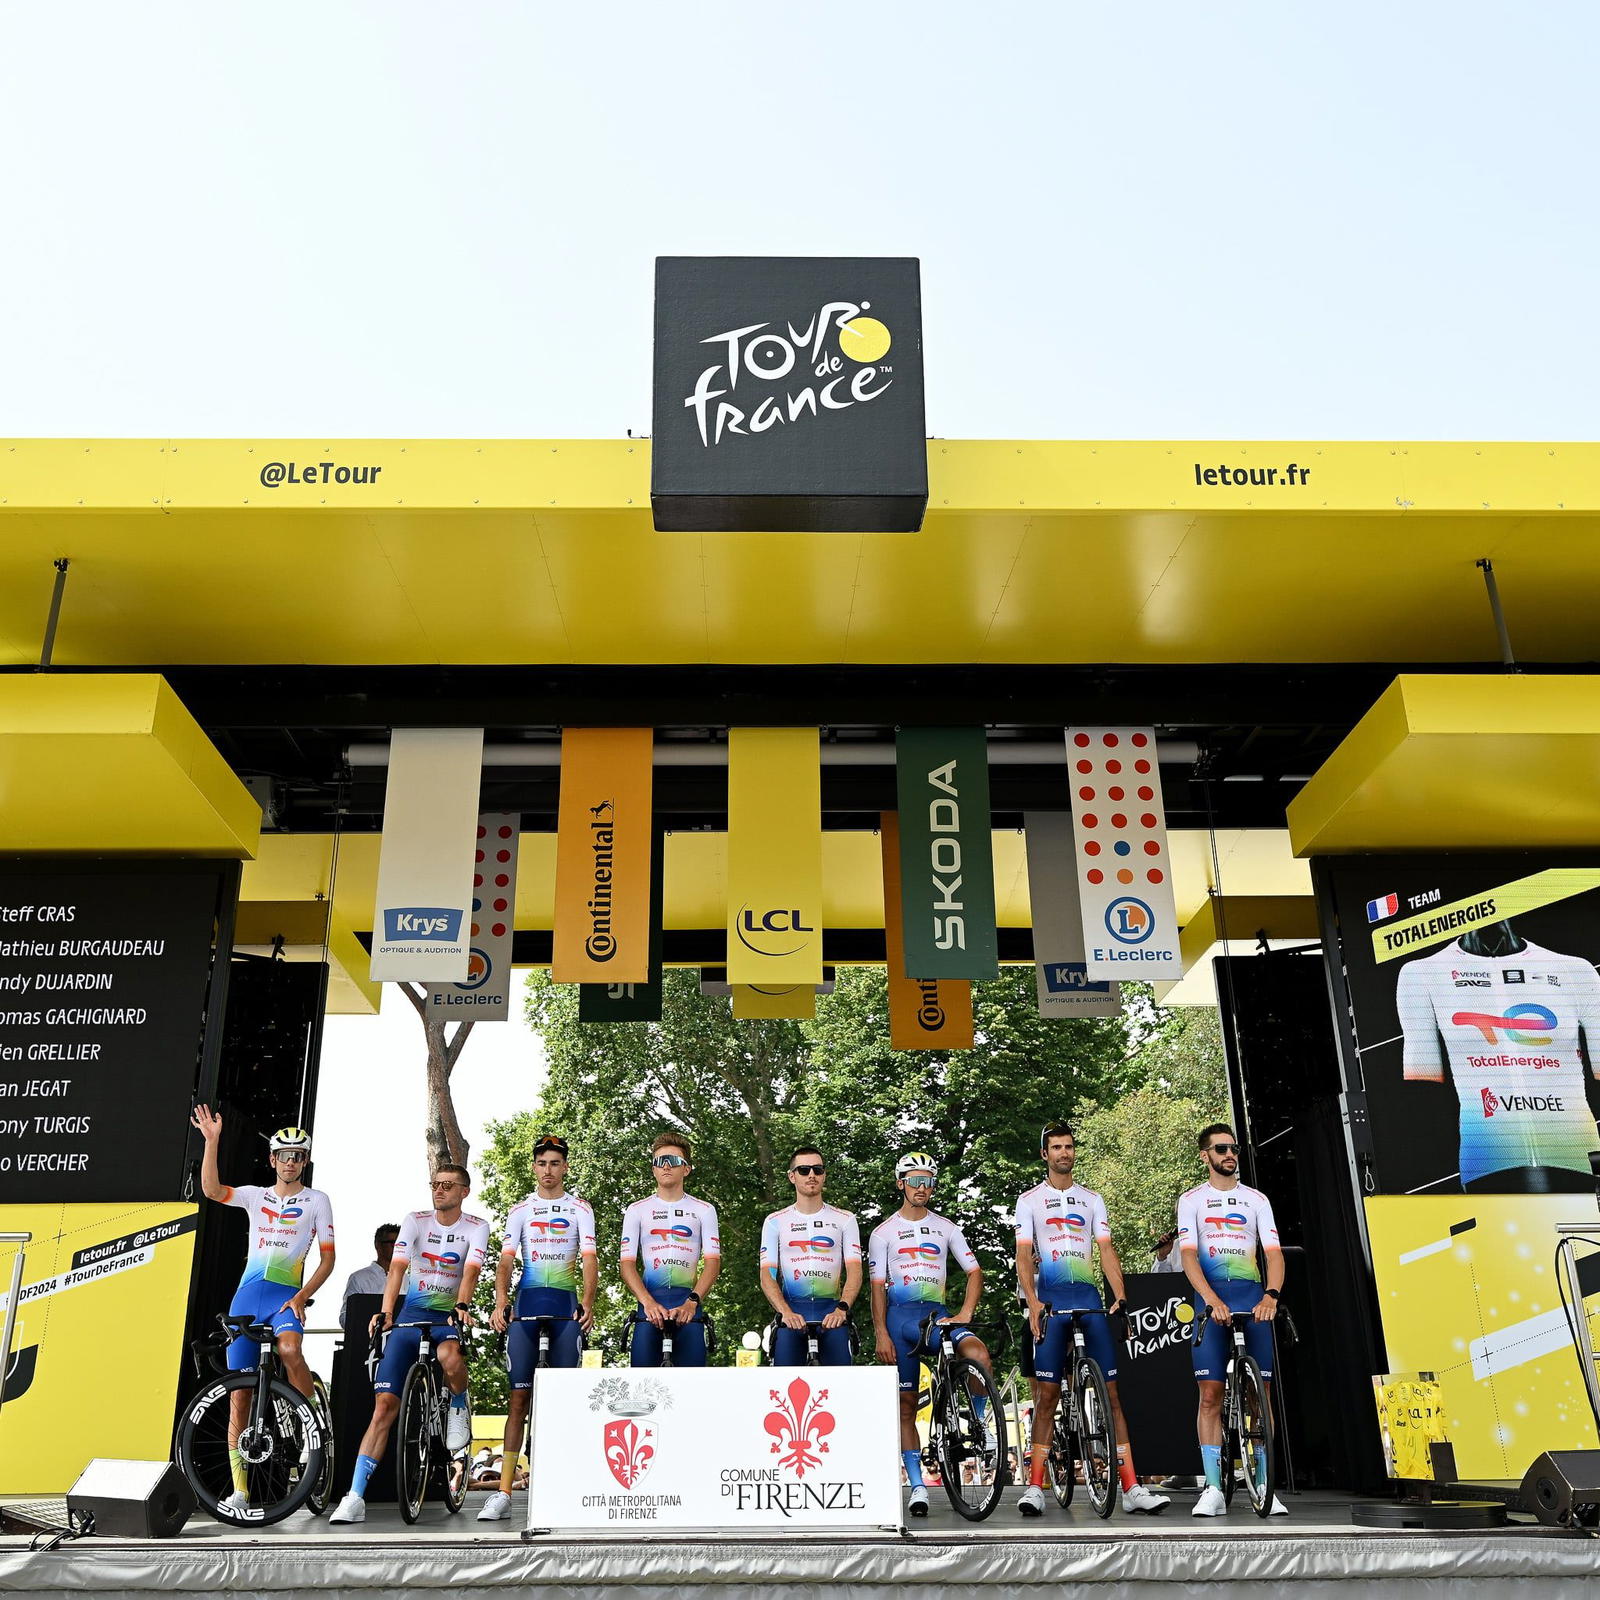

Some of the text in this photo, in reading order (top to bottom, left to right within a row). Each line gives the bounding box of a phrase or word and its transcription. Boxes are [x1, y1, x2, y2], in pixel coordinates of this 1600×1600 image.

[815, 351, 843, 377] de
[260, 462, 381, 488] @LeTour
[1194, 463, 1310, 485] letour.fr
[586, 821, 617, 963] Continental
[1408, 888, 1441, 910] TEAM
[37, 906, 76, 922] CRAS
[745, 910, 814, 932] LCL
[397, 914, 449, 936] Krys
[1384, 899, 1497, 950] TOTALENERGIES
[0, 940, 165, 956] athieu BURGAUDEAU
[1094, 949, 1173, 962] E.Leclerc
[35, 974, 113, 990] DUJARDIN
[1055, 968, 1099, 988] Kry
[434, 994, 502, 1005] E.Leclerc
[46, 1008, 147, 1025] GACHIGNARD
[28, 1044, 101, 1060] GRELLIER
[1467, 1055, 1560, 1070] TotalEnergies
[22, 1080, 71, 1097] JEGAT
[1500, 1094, 1565, 1112] VENDÉE
[34, 1117, 91, 1134] TURGIS
[17, 1154, 89, 1171] VERCHER
[80, 1223, 181, 1264] letour.fr @LeTour
[64, 1252, 145, 1287] #TourDeFrance
[802, 1269, 832, 1279] VENDÉE
[720, 1469, 780, 1482] COMUNE
[582, 1493, 682, 1507] CITTÀ METROPOLITANA
[721, 1483, 866, 1517] DI FIRENZE
[609, 1508, 657, 1519] DI FIRENZE
